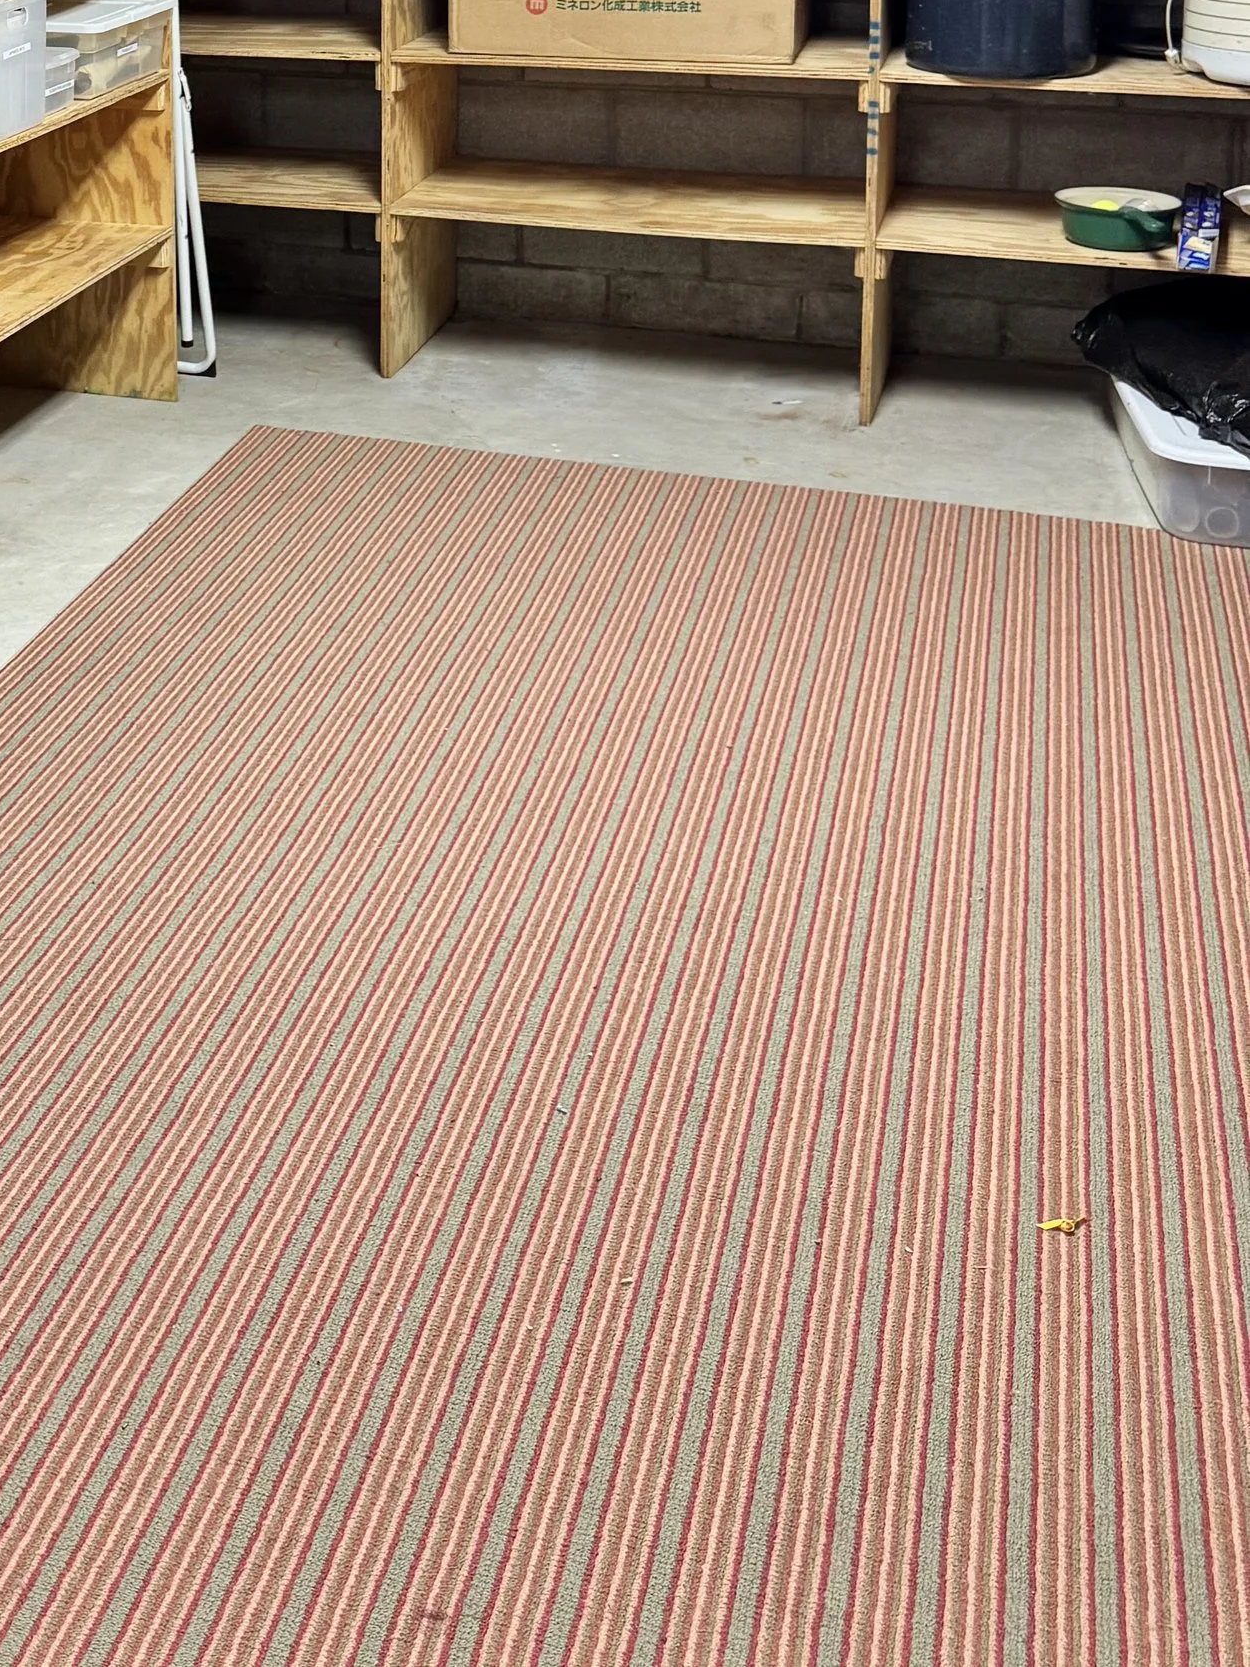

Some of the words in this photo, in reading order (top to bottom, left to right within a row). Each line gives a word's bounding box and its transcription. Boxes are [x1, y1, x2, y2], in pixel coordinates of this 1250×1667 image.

[556, 0, 702, 13] ミネロン化成工業株式会社
